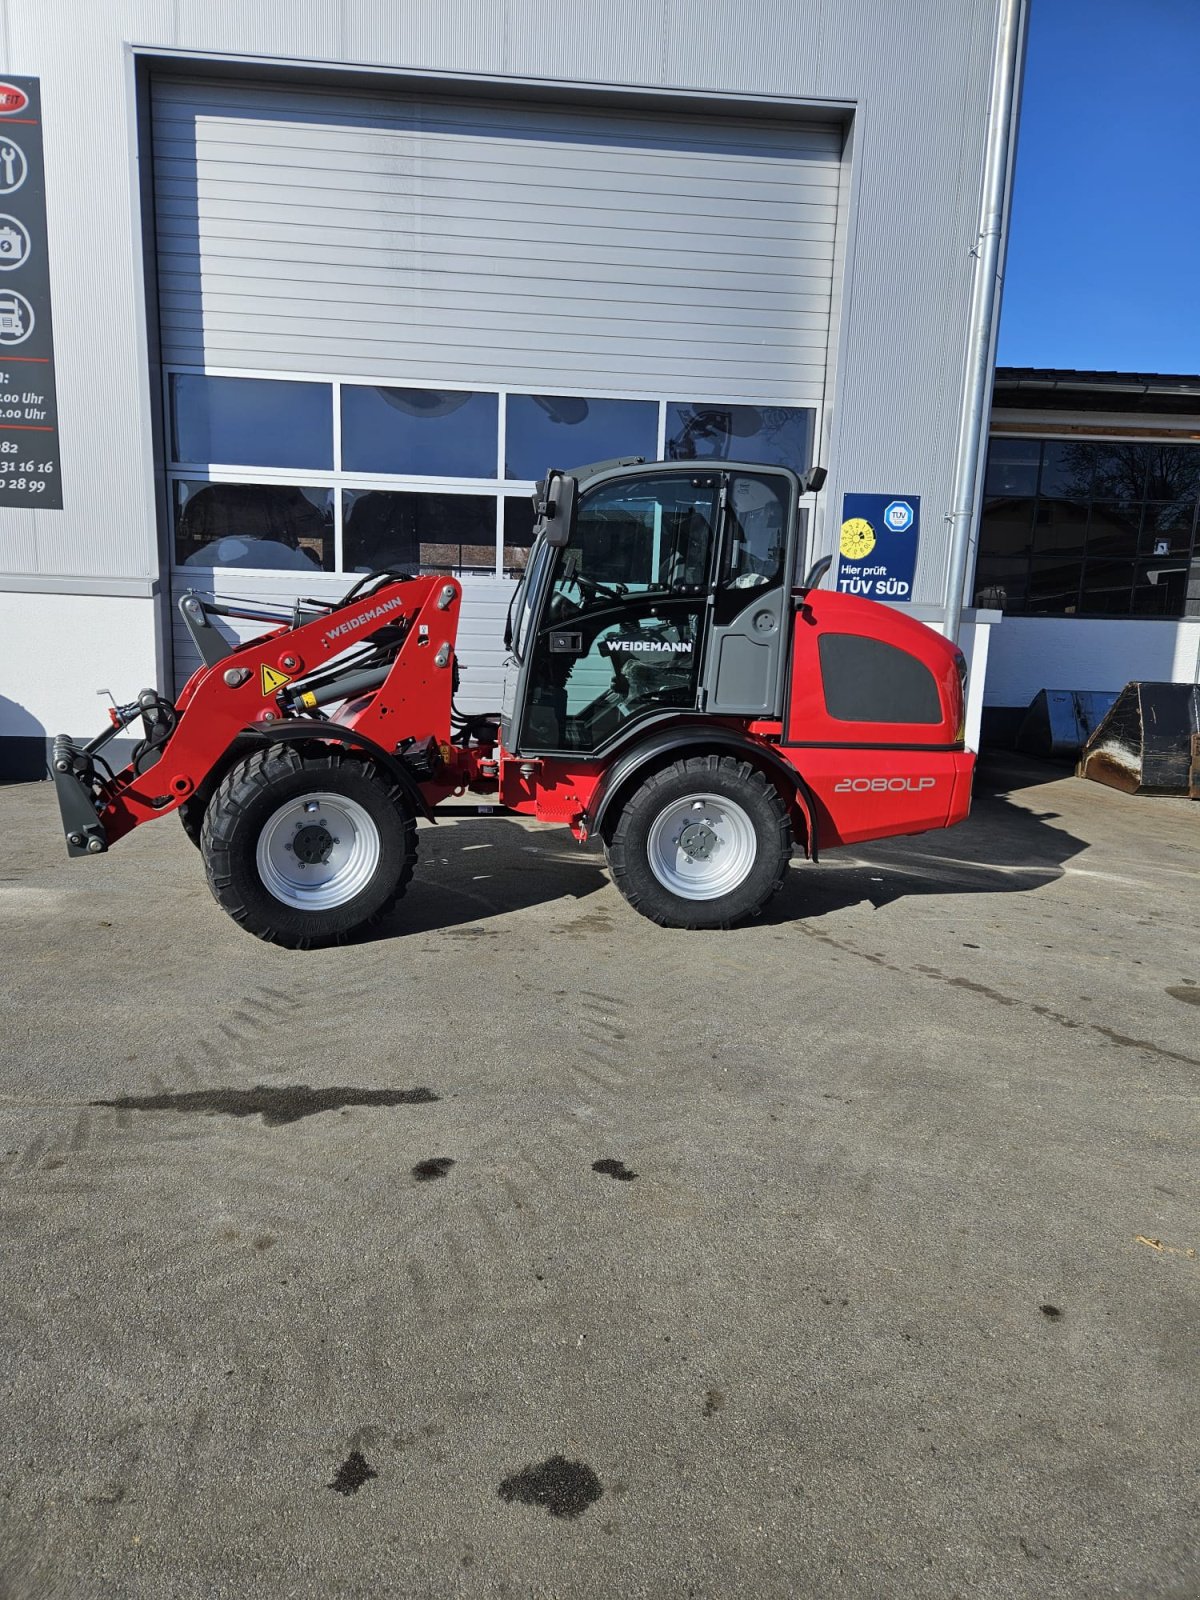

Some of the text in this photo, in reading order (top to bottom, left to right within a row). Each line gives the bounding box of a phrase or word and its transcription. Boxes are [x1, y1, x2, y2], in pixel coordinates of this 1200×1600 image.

[0, 392, 44, 404] .00 Uhr
[24, 408, 46, 420] Uhr
[0, 441, 18, 453] 82
[0, 460, 53, 473] 31 16 16
[8, 478, 26, 489] 28
[28, 480, 46, 492] 99
[841, 565, 887, 577] Hier prüft
[840, 577, 909, 595] TÜV SÜD
[325, 597, 402, 640] WEIDEMANN
[606, 641, 692, 653] WEIDEMANN
[834, 777, 936, 792] 2080LP
